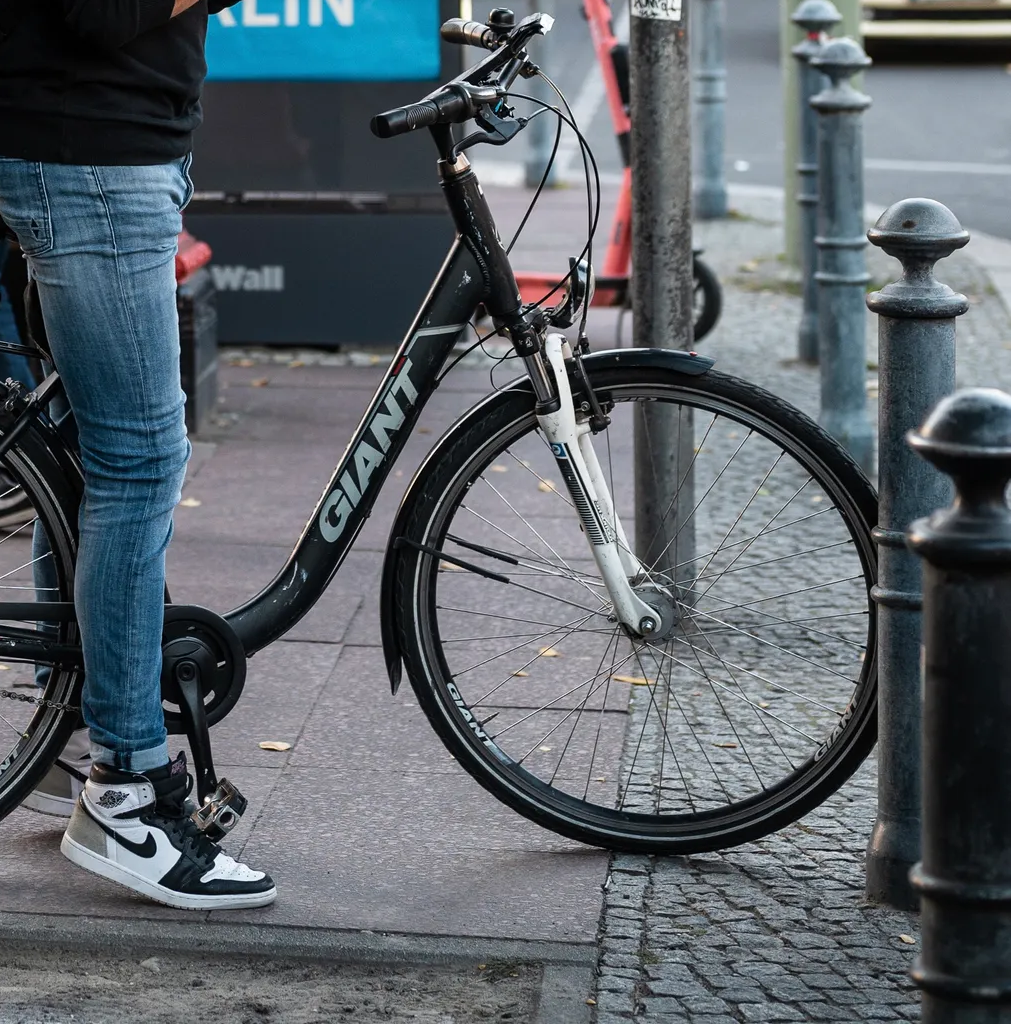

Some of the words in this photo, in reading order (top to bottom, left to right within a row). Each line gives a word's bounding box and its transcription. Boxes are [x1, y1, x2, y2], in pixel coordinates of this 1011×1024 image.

[211, 265, 285, 291] Wall
[319, 359, 420, 543] GIANT
[447, 682, 497, 748] GIANT
